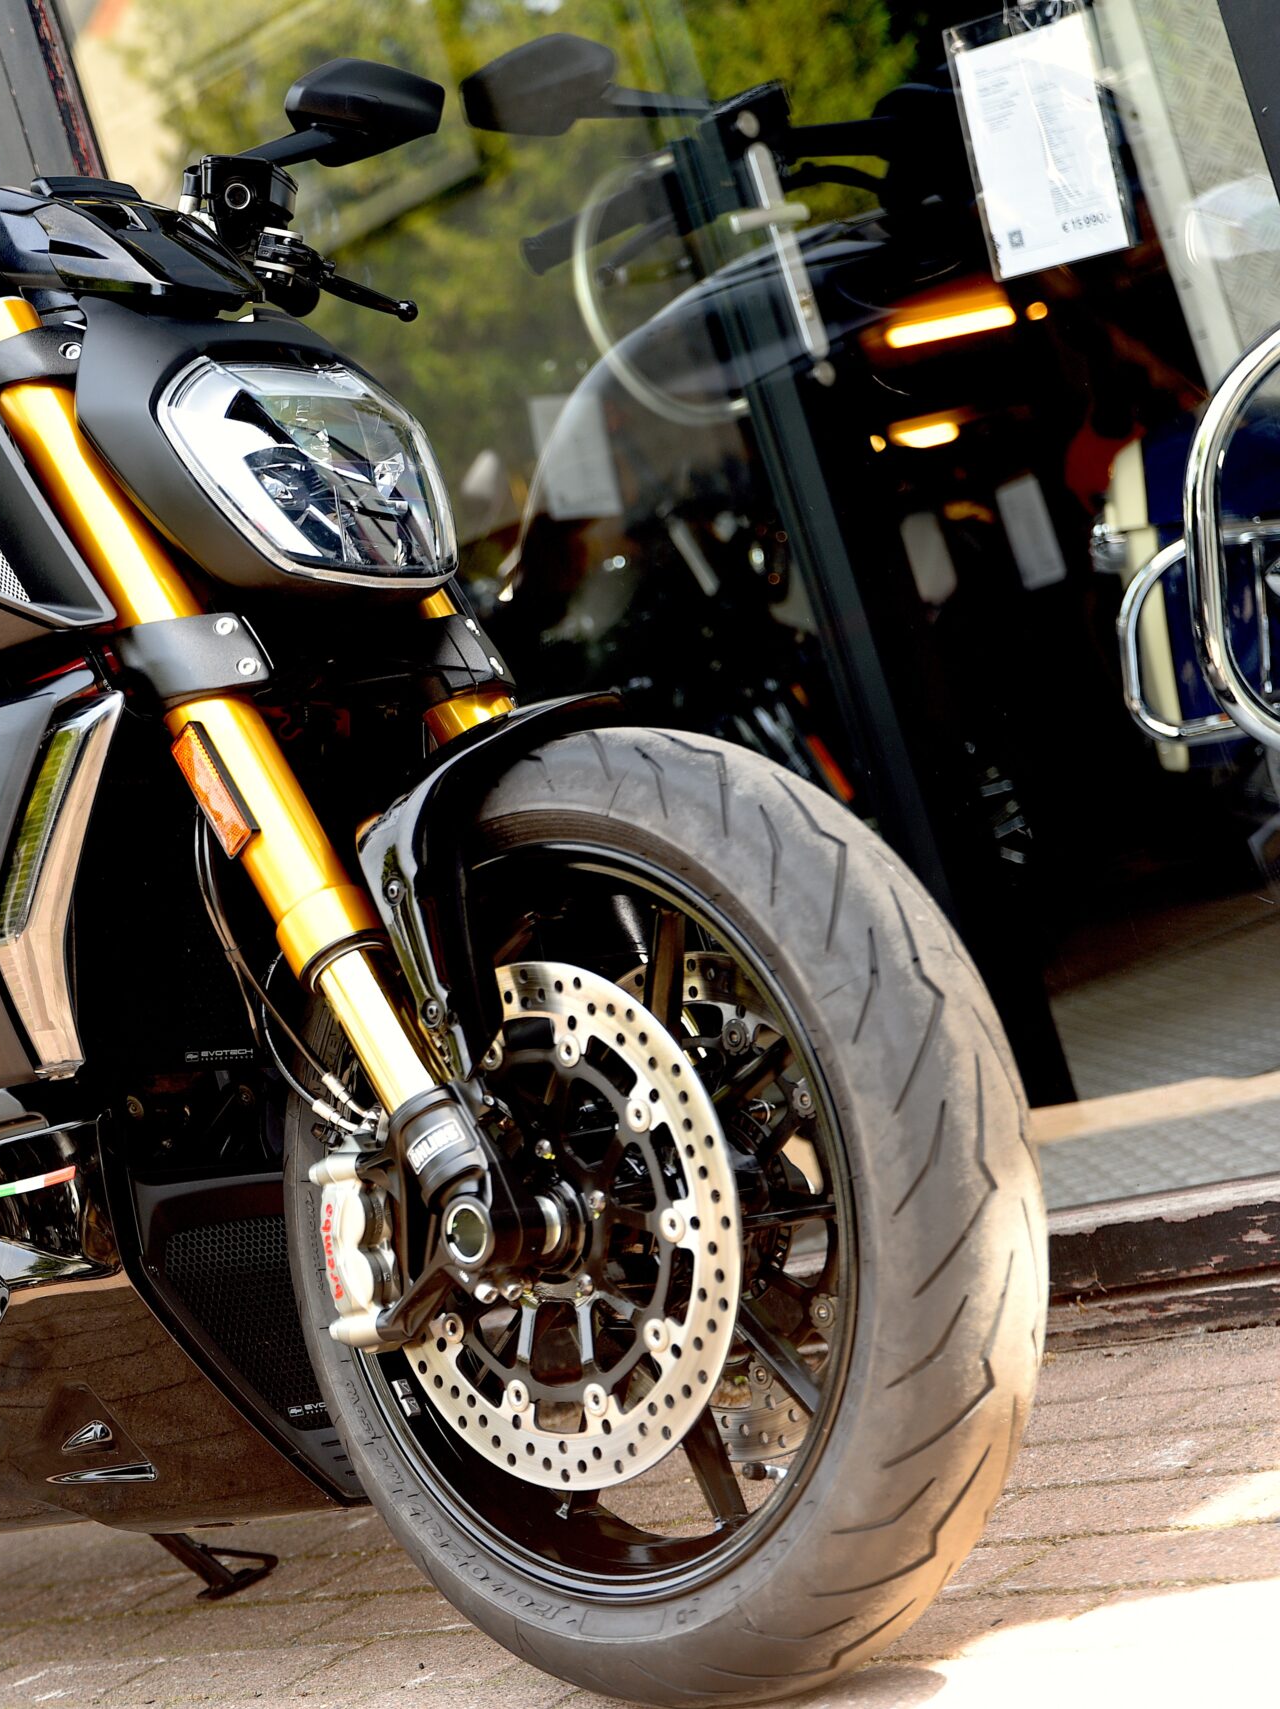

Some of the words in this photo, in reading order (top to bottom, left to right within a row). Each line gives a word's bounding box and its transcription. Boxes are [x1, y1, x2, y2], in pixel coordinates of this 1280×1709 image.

[200, 1048, 254, 1057] EVOTECH
[320, 1203, 345, 1301] brembo
[304, 1402, 328, 1410] EVO
